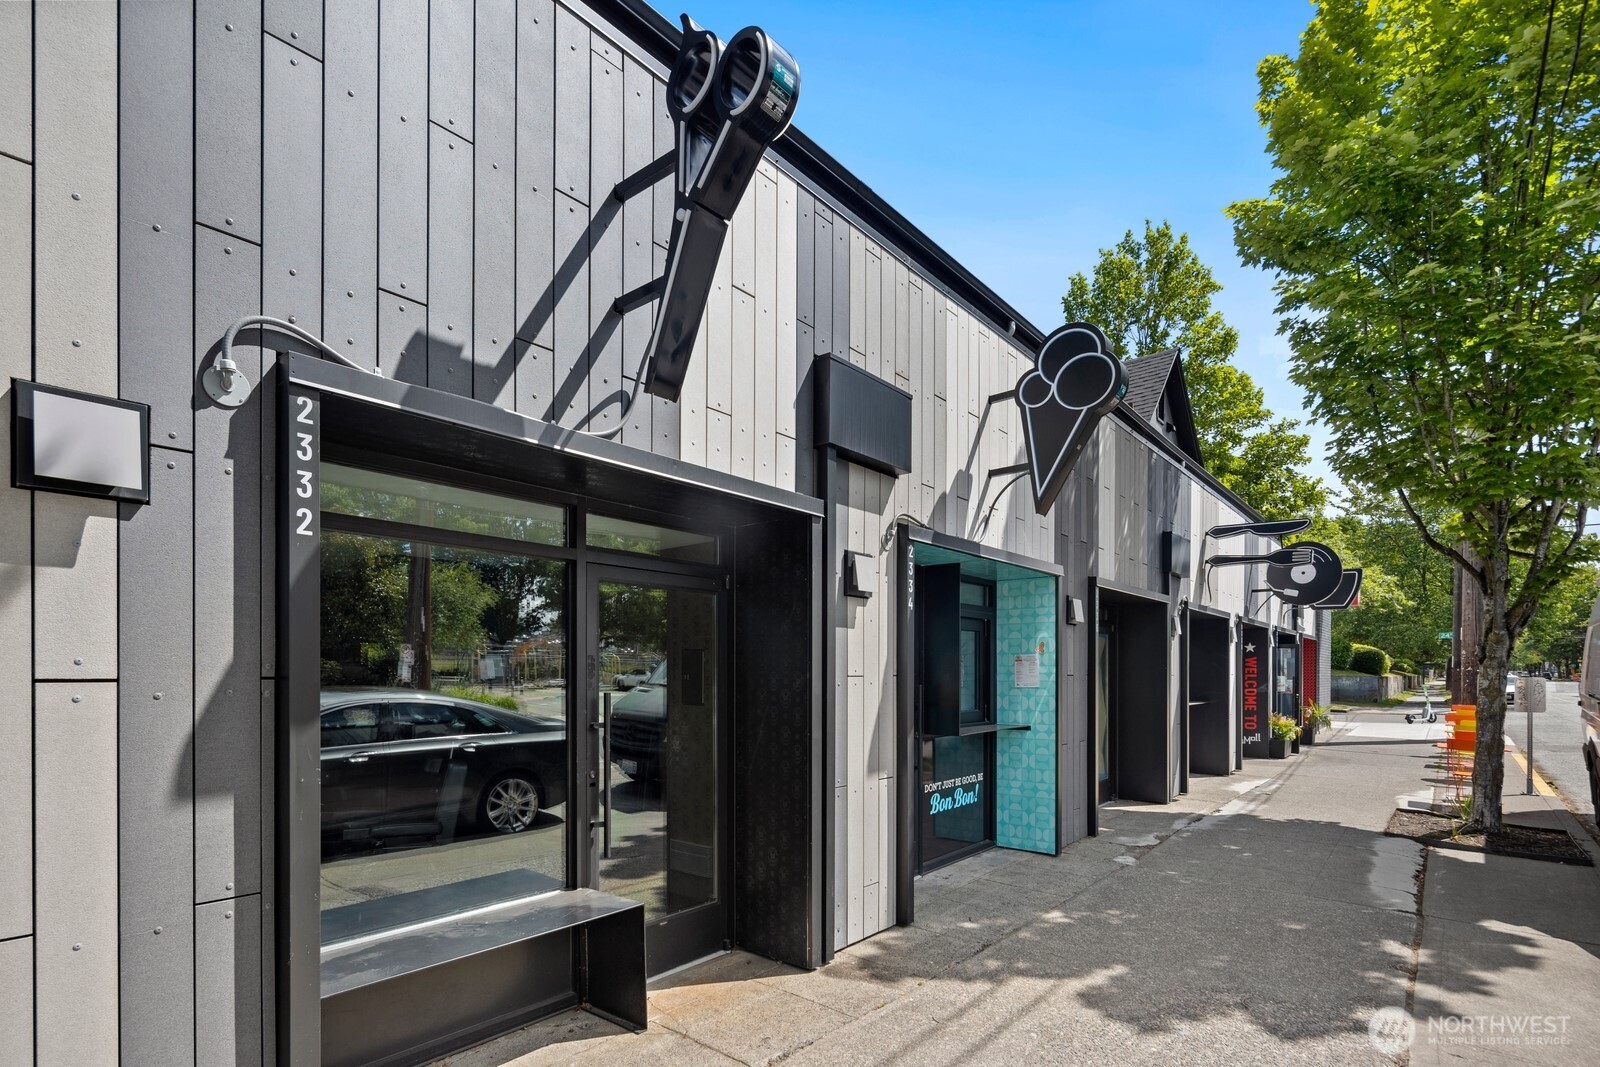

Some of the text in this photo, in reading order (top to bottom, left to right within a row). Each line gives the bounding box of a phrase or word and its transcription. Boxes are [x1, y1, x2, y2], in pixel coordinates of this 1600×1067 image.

[296, 396, 314, 536] 2332
[1244, 656, 1258, 730] WELCOME TO
[924, 782, 942, 793] DON'T
[942, 779, 955, 789] JUST
[955, 778, 961, 786] BE
[977, 773, 983, 781] BE
[929, 783, 979, 815] Bon Bon!
